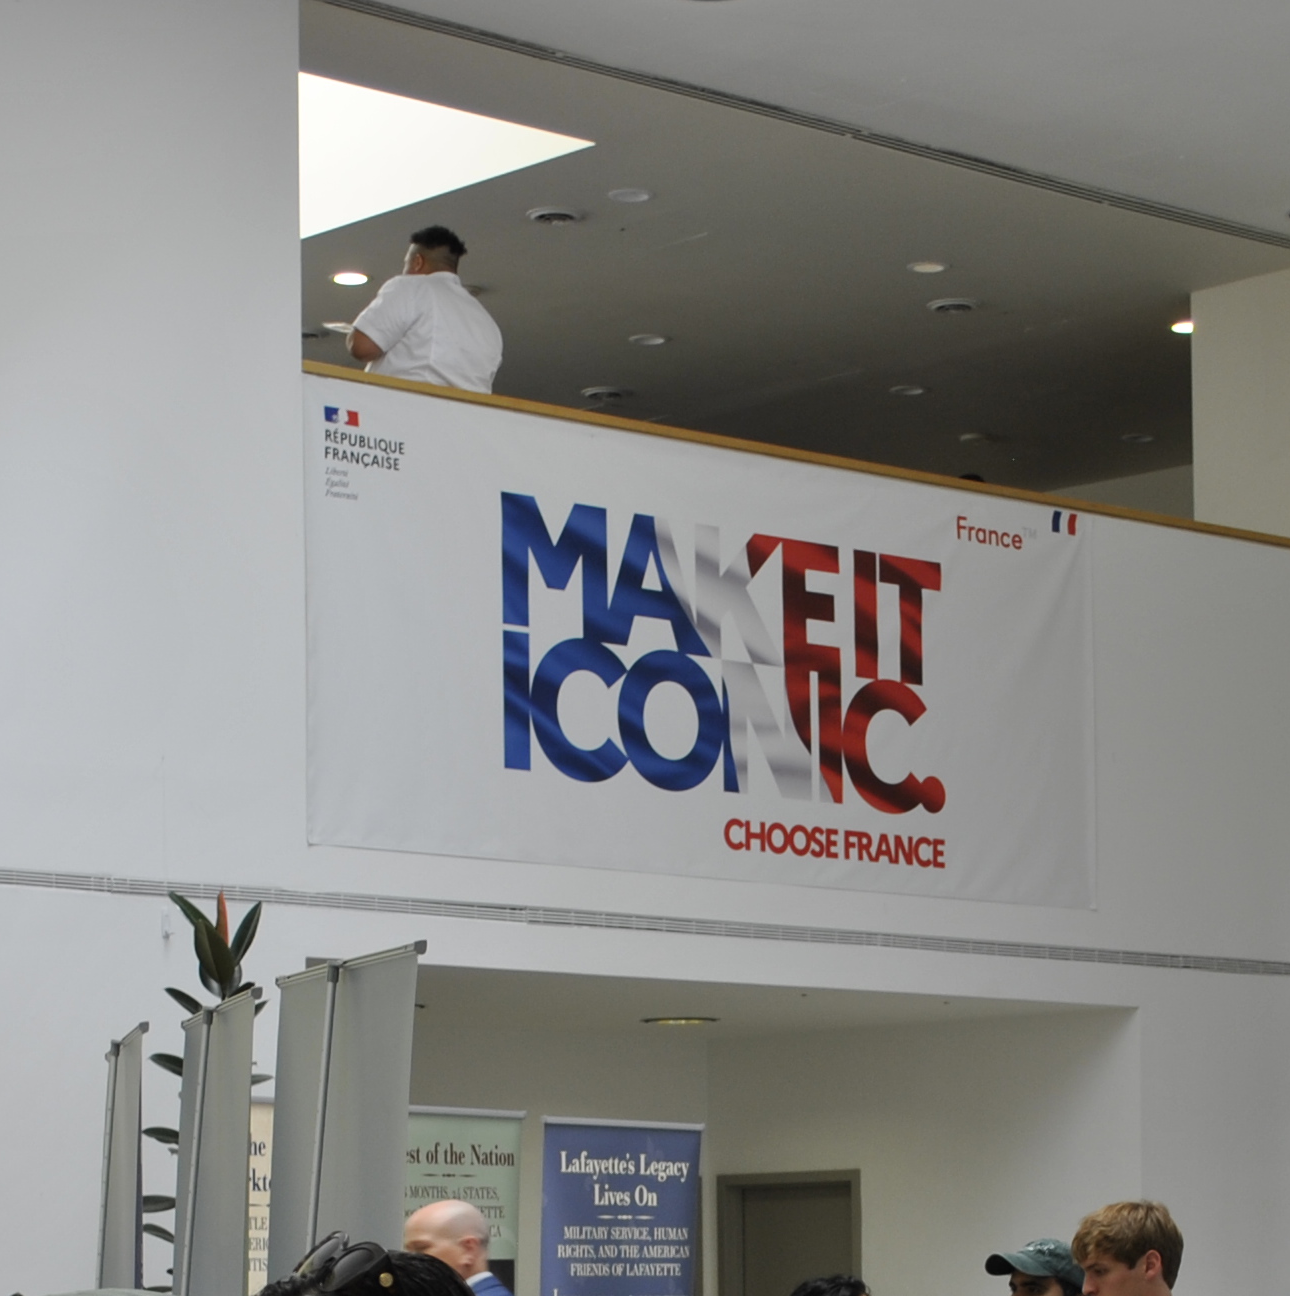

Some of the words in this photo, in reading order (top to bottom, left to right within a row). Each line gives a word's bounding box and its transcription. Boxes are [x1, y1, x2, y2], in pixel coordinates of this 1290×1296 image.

[324, 428, 405, 455] RÉPUBLIQUE
[324, 446, 400, 471] FRANÇAISE
[956, 515, 1023, 551] France
[723, 818, 839, 859] CHOOSE
[844, 829, 946, 868] FRANCE
[426, 1142, 440, 1165] of
[444, 1142, 466, 1165] the
[470, 1144, 515, 1167] Nation
[560, 1150, 635, 1180] Lafayette's
[639, 1153, 690, 1182] Legacy
[463, 1186, 500, 1201] STATES,
[594, 1183, 631, 1206] Lives
[634, 1185, 658, 1207] On
[563, 1226, 609, 1240] MILITARY
[611, 1226, 652, 1241] SERVICE,
[654, 1227, 689, 1241] HUMAN
[558, 1244, 596, 1259] RIGHTS,
[598, 1245, 618, 1258] AND
[619, 1245, 640, 1258] THE
[642, 1245, 690, 1259] AMERICAN
[570, 1263, 610, 1277] FRIENDS
[611, 1263, 625, 1277] OF
[626, 1263, 681, 1277] LAFAYETTE
